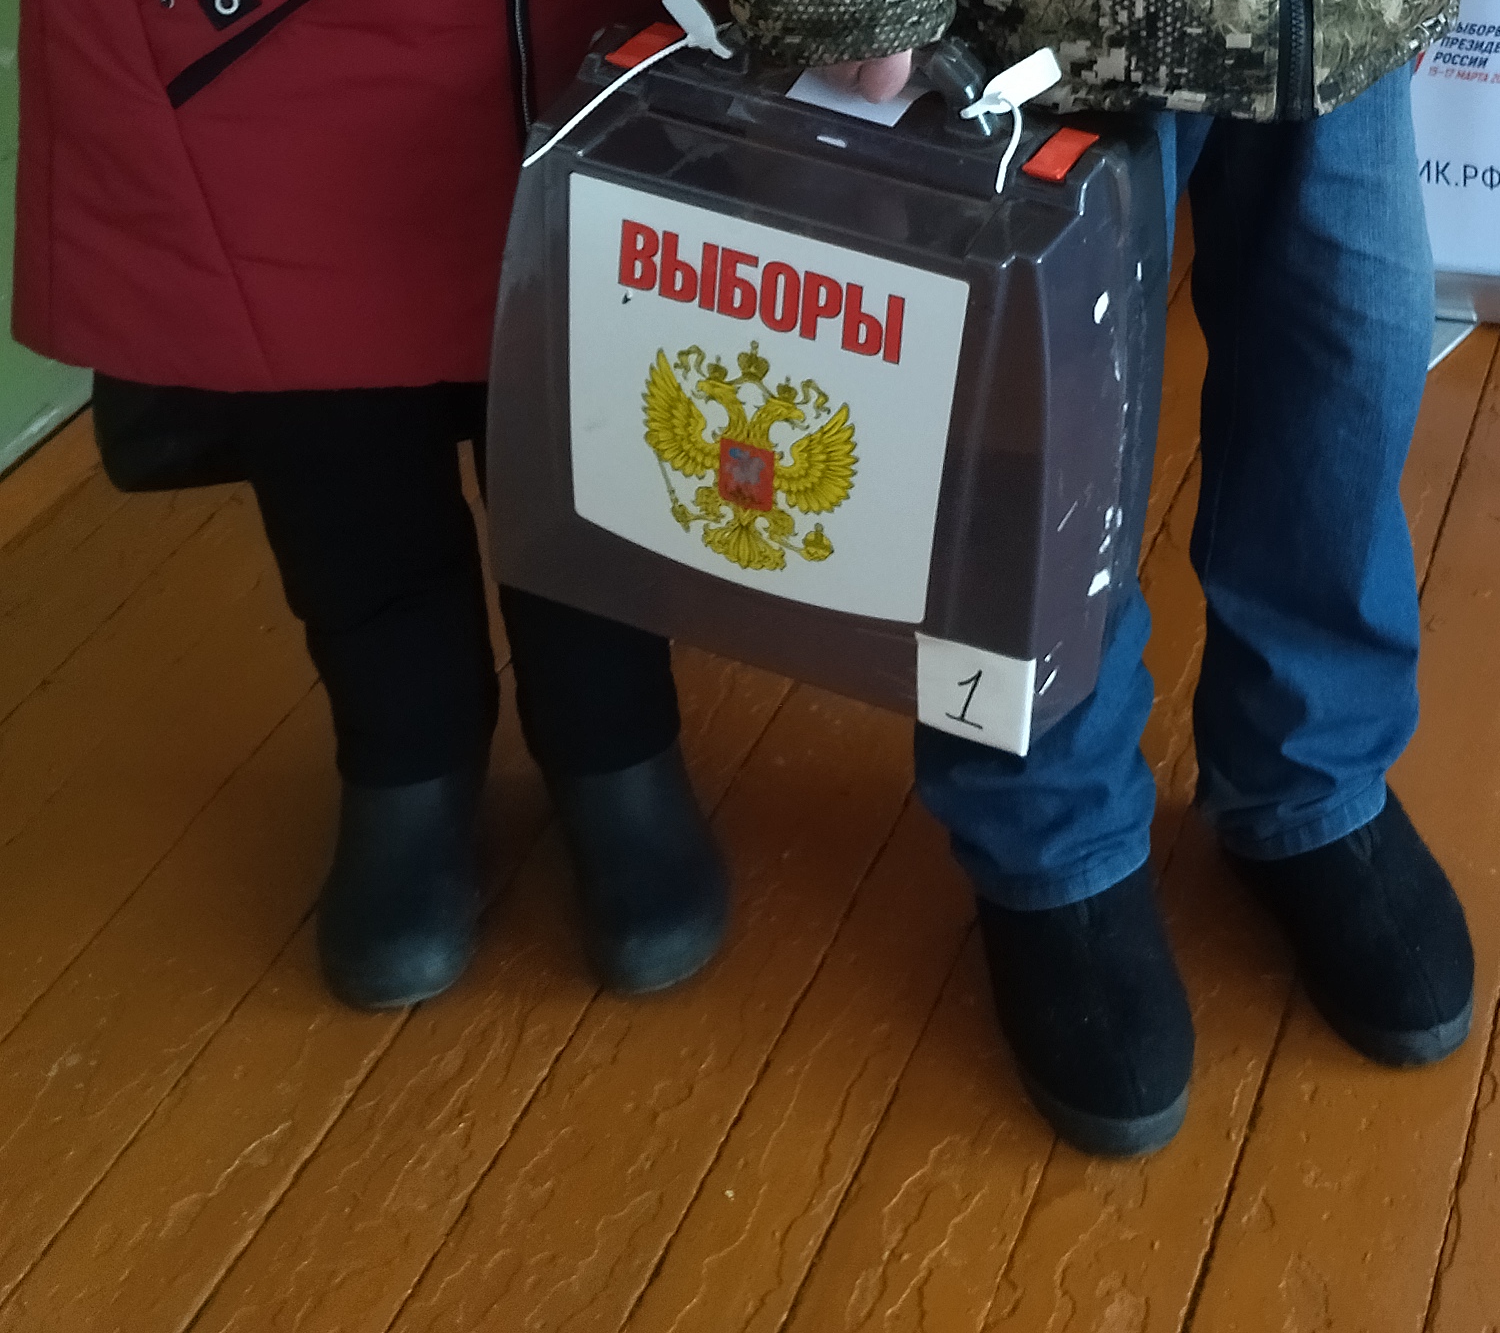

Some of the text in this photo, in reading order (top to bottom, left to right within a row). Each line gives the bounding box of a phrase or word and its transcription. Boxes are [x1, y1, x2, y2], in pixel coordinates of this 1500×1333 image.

[1433, 52, 1488, 68] РОССИИ
[618, 219, 905, 364] ВЫБОРЫ
[945, 669, 983, 730] 1
